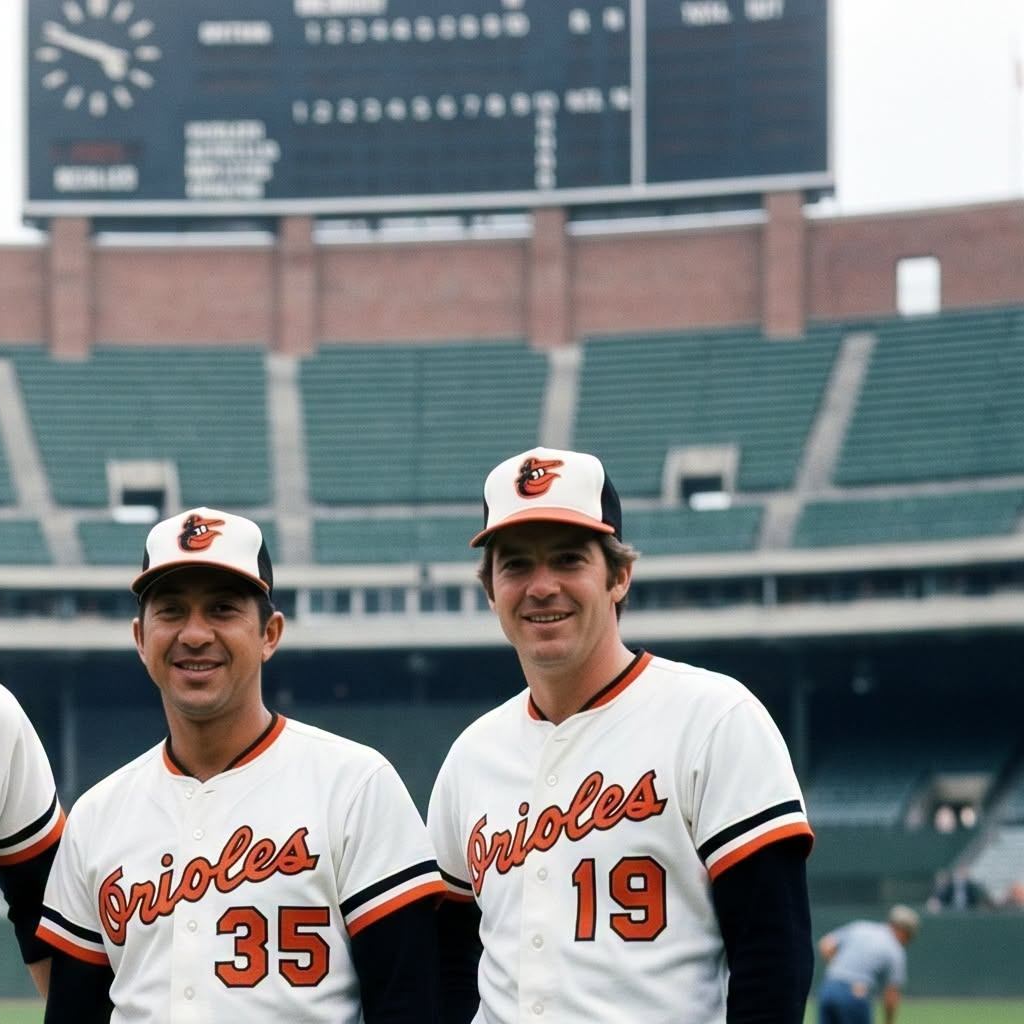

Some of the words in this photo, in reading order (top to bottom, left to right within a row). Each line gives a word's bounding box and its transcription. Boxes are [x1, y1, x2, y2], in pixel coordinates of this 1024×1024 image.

[468, 769, 668, 897] Orioles
[98, 825, 320, 946] Orioles
[572, 855, 667, 942] 19
[214, 905, 331, 988] 35
